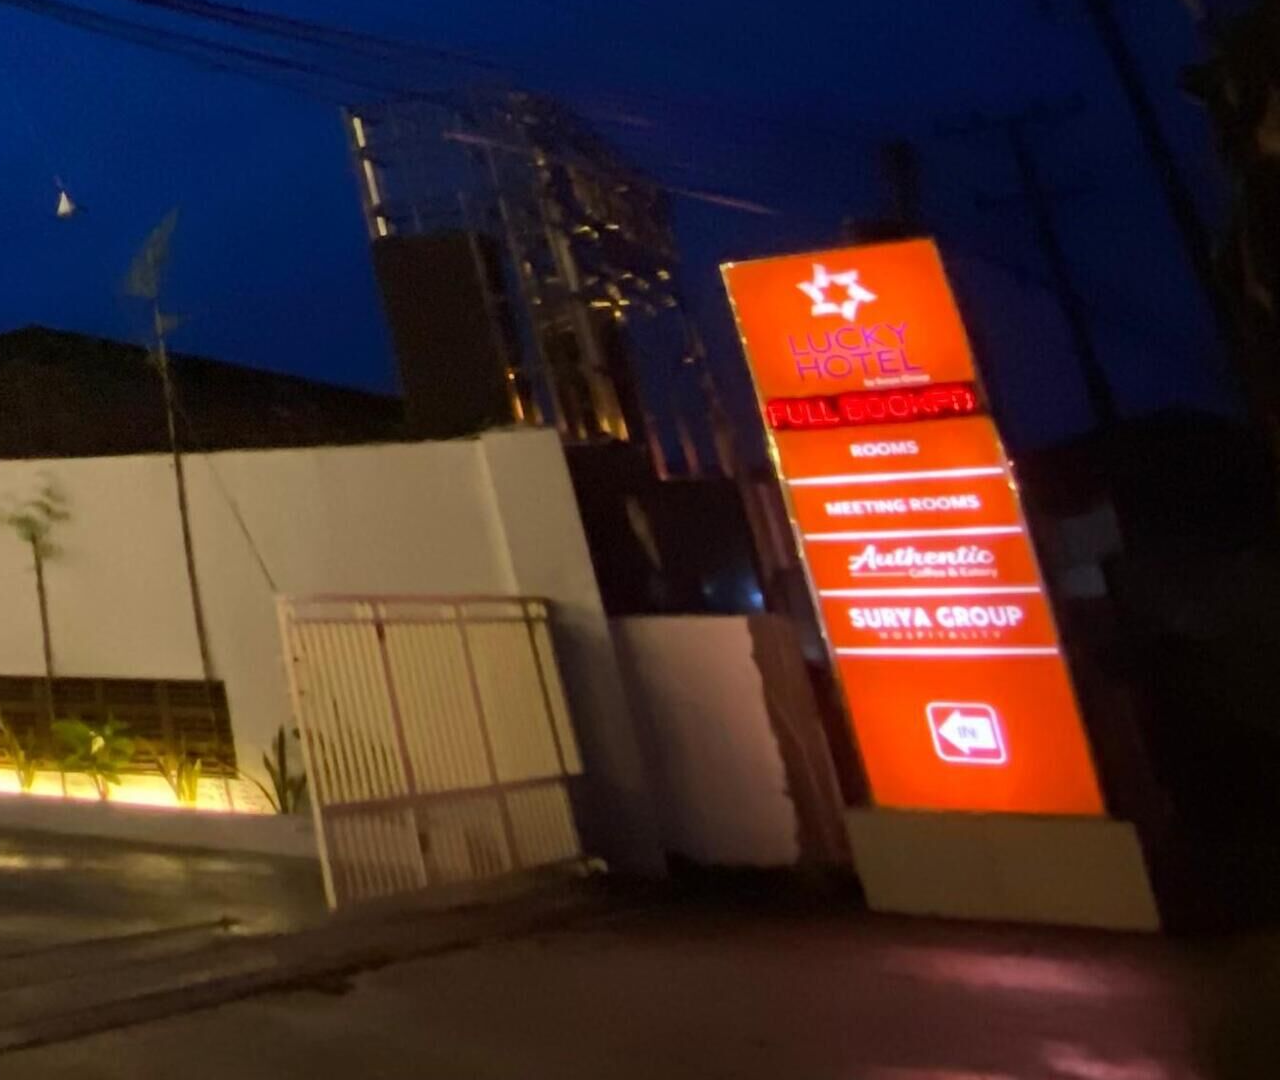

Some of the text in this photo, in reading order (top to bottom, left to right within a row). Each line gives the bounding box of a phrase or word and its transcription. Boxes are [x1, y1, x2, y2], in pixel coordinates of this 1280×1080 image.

[789, 322, 907, 354] LUCKY
[797, 349, 922, 380] HOTEL
[768, 401, 839, 427] FULL
[850, 440, 919, 457] ROOMS
[825, 494, 981, 516] MEETING ROOMS
[848, 544, 994, 570] Authentic
[849, 605, 1023, 628] SURYA GROUP
